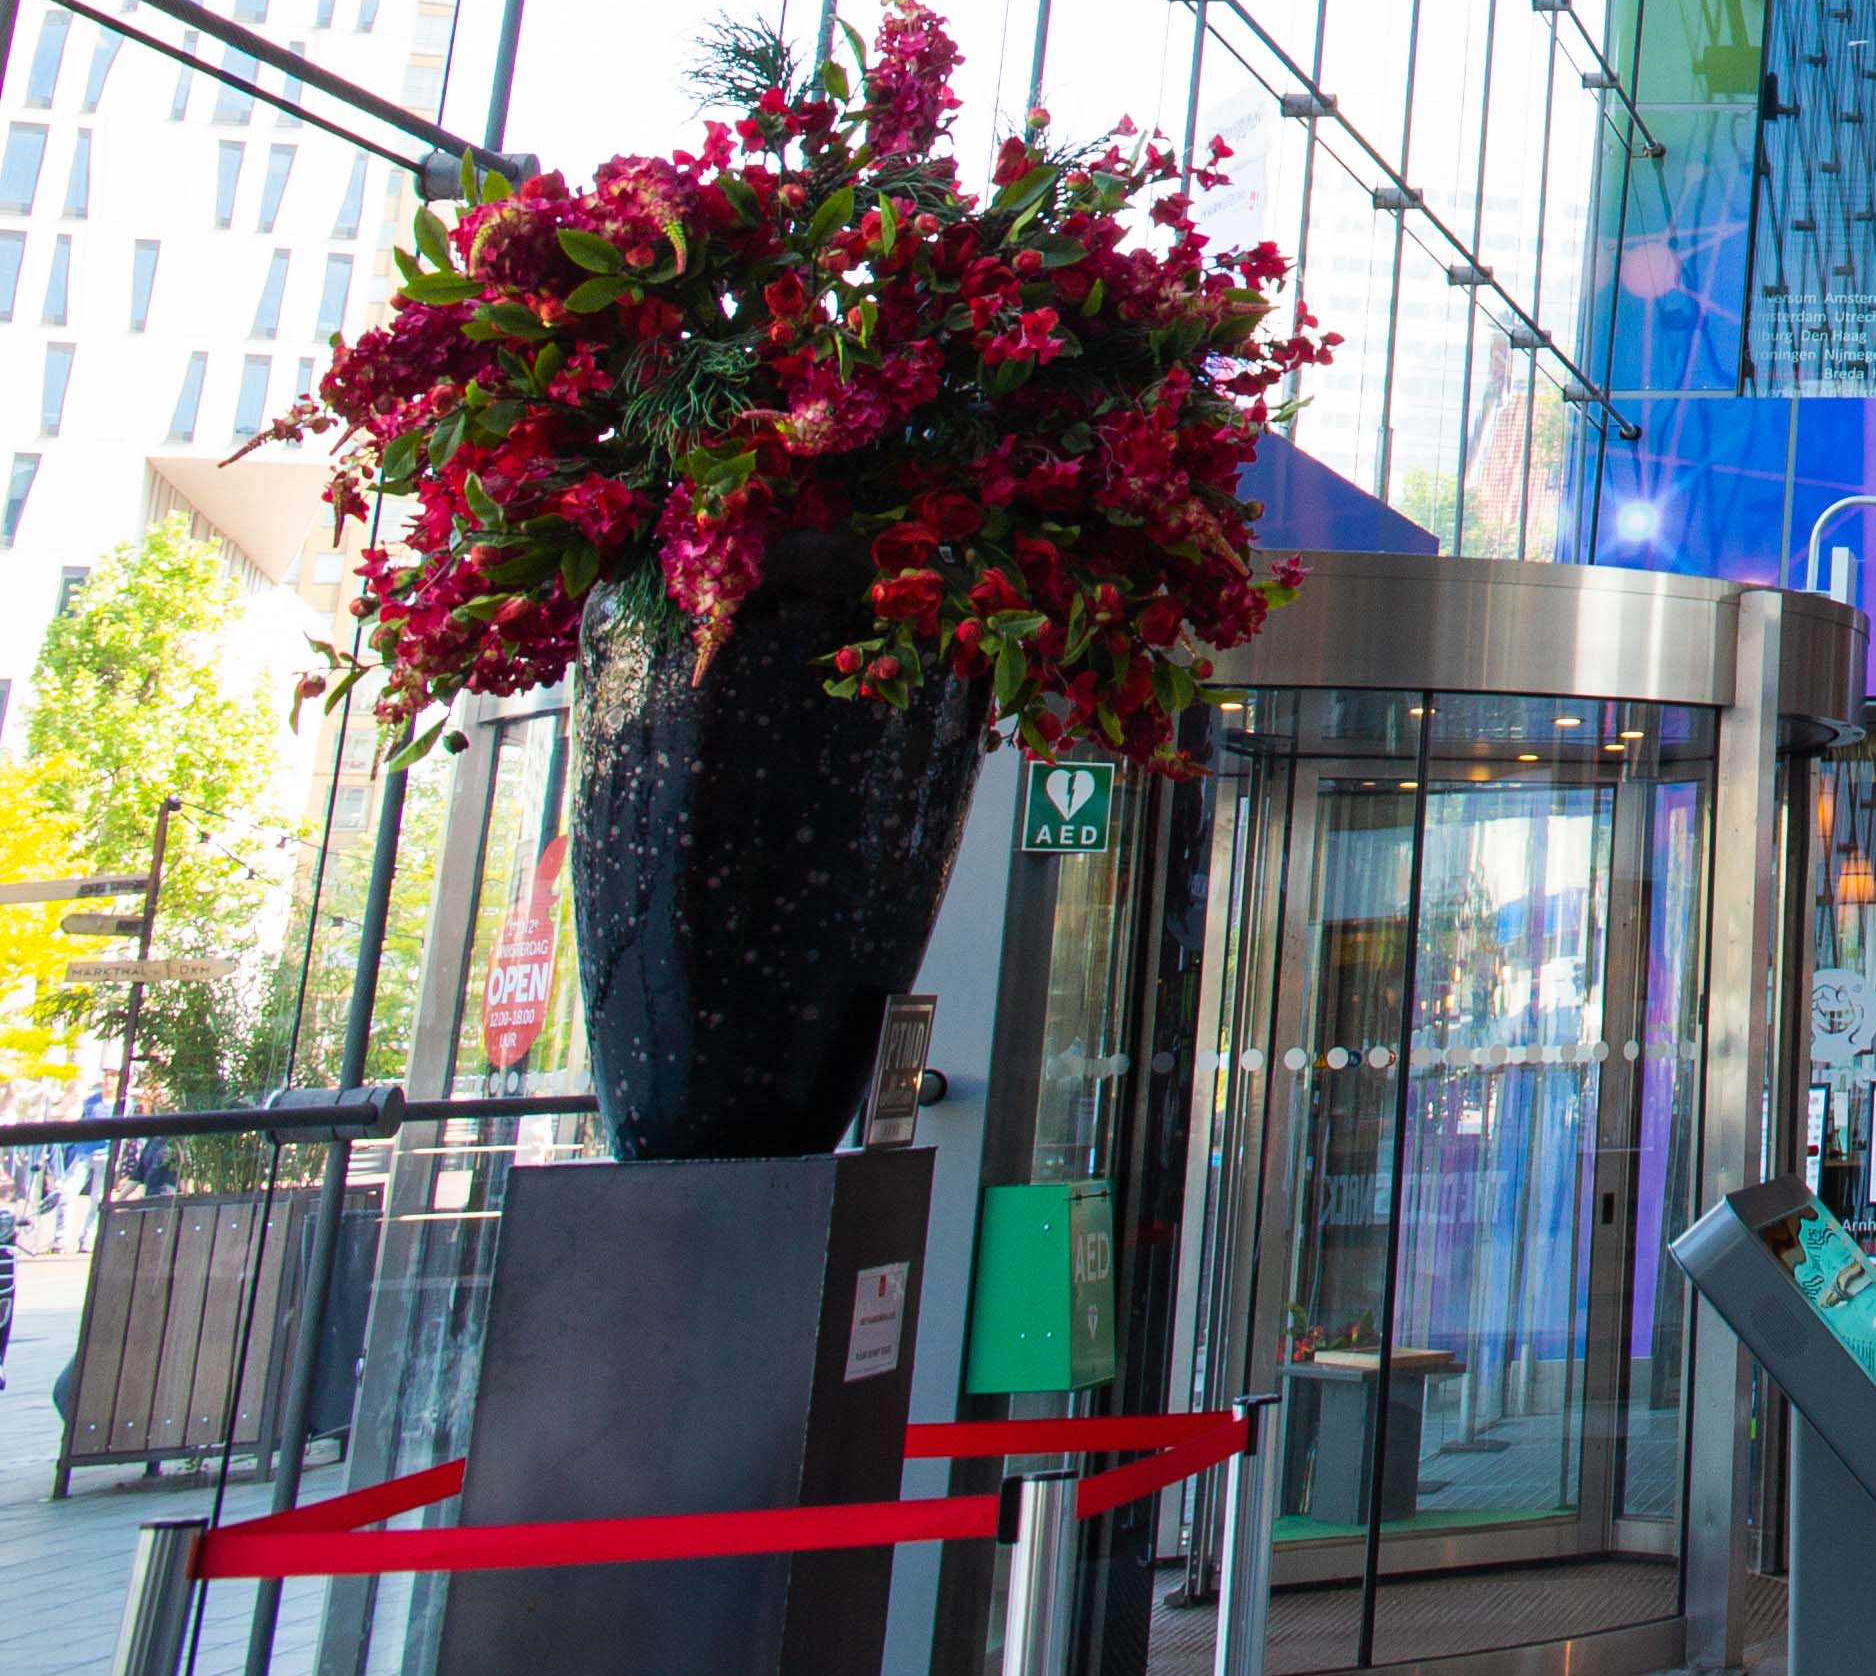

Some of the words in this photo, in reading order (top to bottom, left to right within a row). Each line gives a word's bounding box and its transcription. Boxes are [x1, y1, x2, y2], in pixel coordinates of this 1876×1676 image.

[1801, 328, 1828, 342] Den
[1832, 328, 1867, 344] Haag
[1823, 367, 1864, 380] Breda
[1035, 825, 1098, 845] AED
[488, 962, 549, 1006] OPEN
[1074, 1231, 1111, 1285] AED
